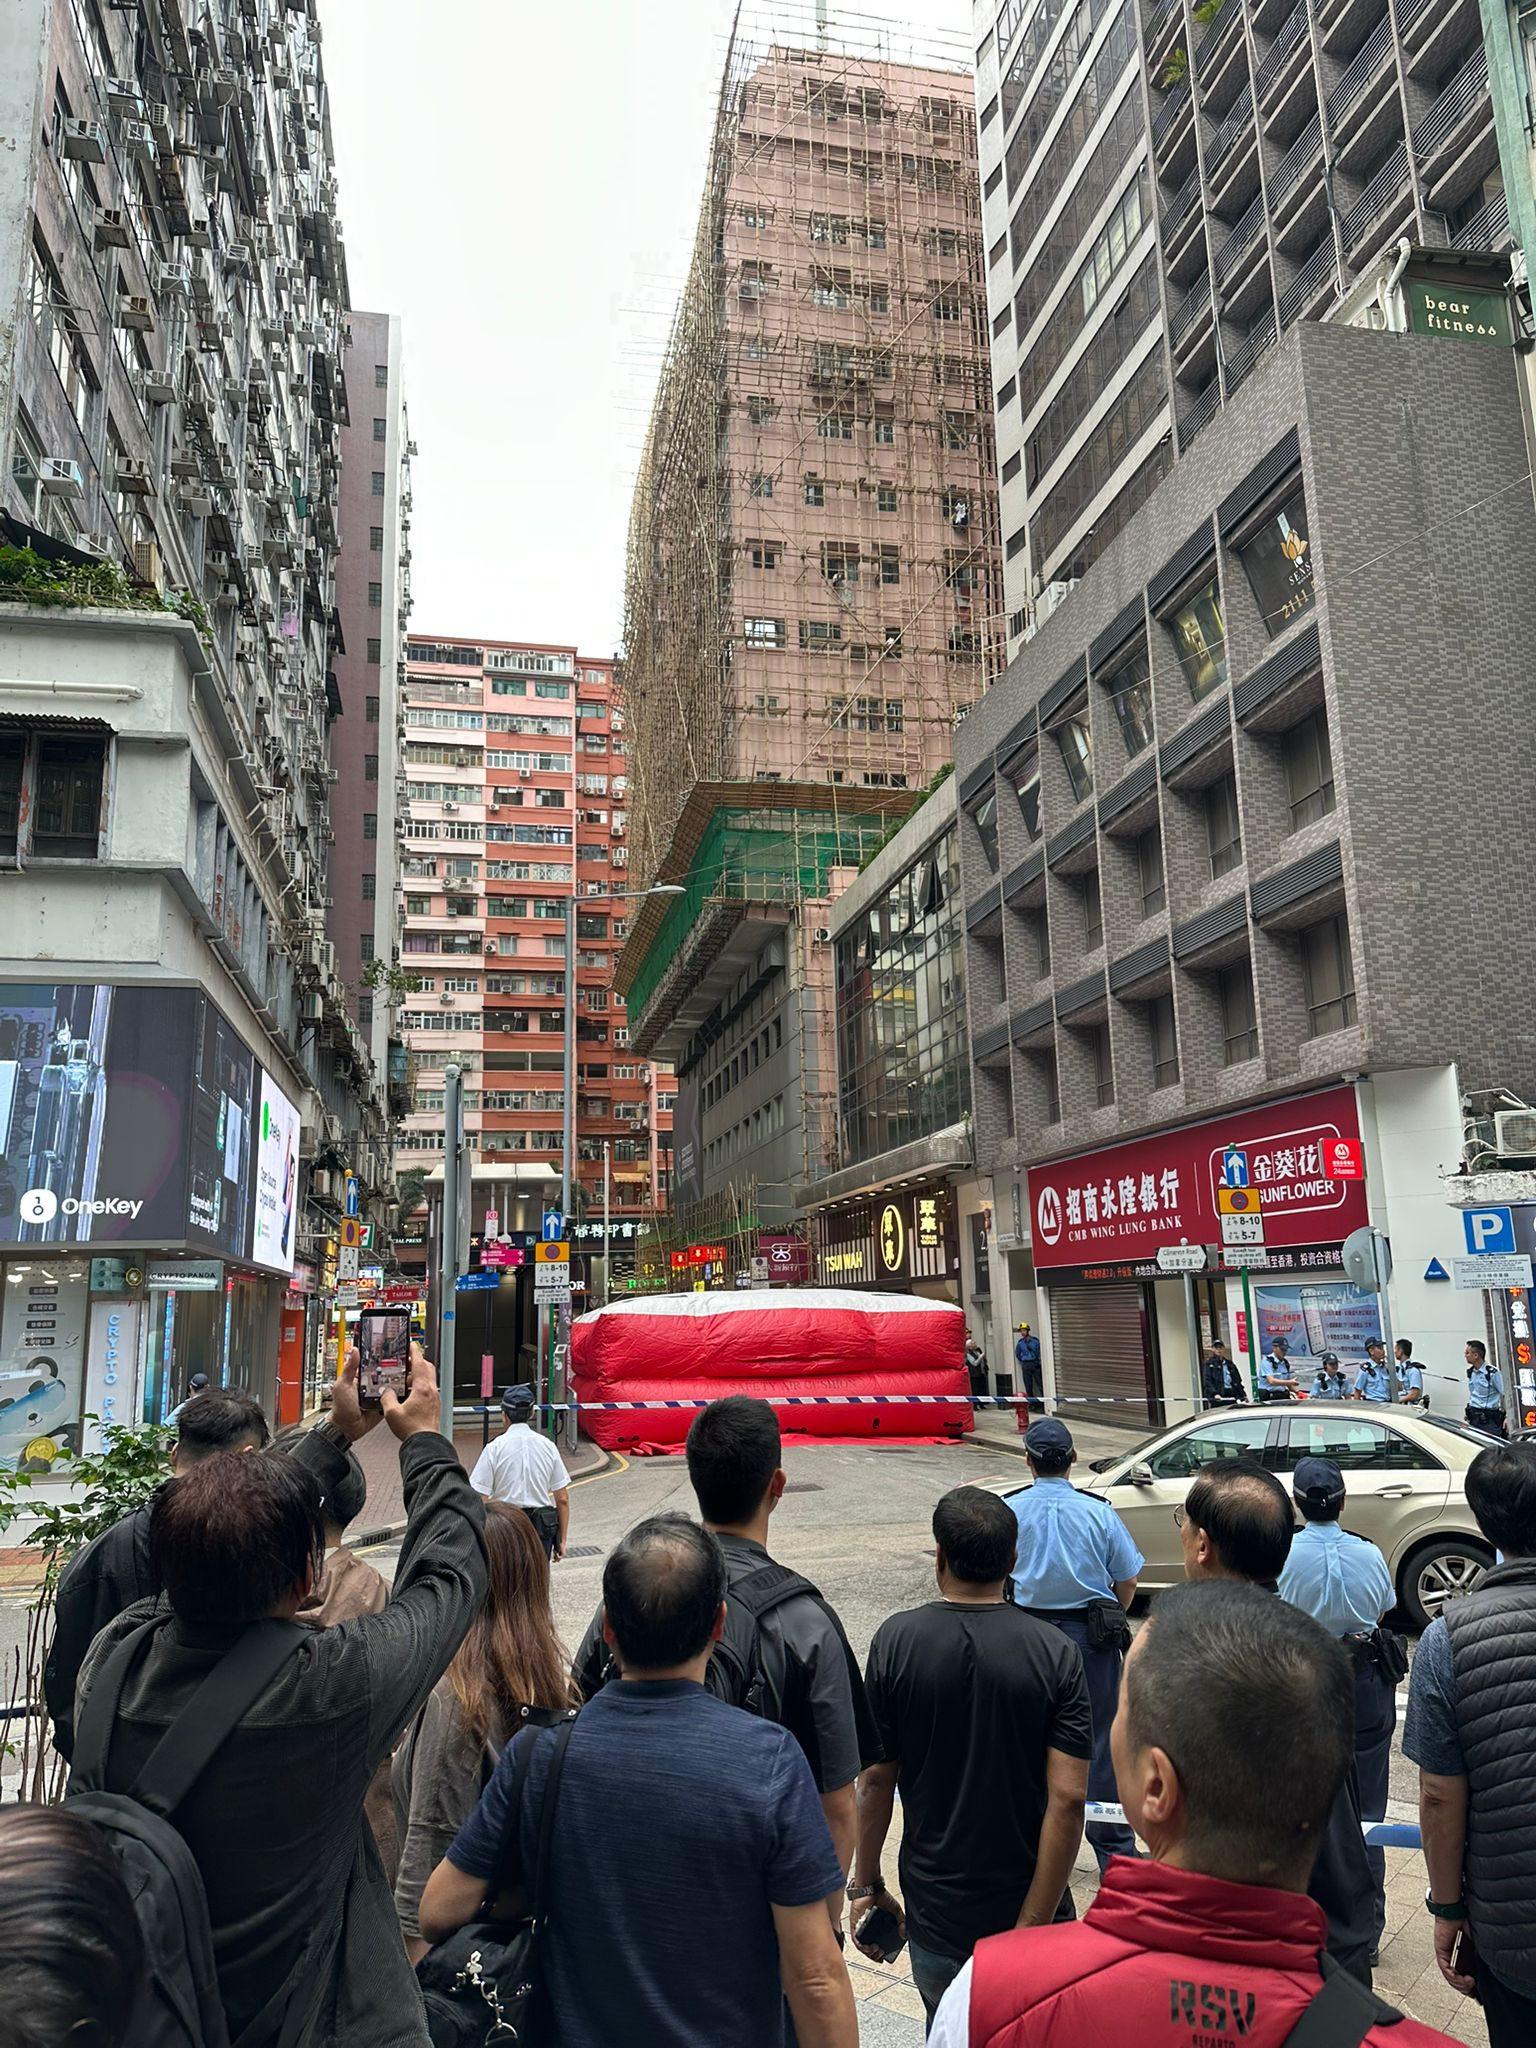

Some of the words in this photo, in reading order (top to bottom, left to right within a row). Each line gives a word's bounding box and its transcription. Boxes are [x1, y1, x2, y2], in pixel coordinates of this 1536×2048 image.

[1425, 295, 1470, 315] bear
[1427, 314, 1497, 336] fitness
[1253, 1145, 1320, 1184] 金葵花
[1066, 1167, 1180, 1225] 招商永隆銀行
[1259, 1180, 1335, 1204] SUNFLOWER
[61, 1197, 143, 1219] OneKey
[1068, 1227, 1087, 1242] CMB
[1090, 1224, 1115, 1239] WING
[1119, 1220, 1147, 1236] LUNG
[1151, 1215, 1183, 1231] BANK
[1239, 1216, 1260, 1225] 8-10
[1471, 1213, 1503, 1250] P
[1242, 1231, 1256, 1240] 5-7
[824, 1254, 843, 1273] TSUI
[842, 1251, 863, 1269] WAH
[151, 1272, 187, 1280] CRYPTO
[103, 1314, 121, 1386] CRYPTO
[1171, 1980, 1256, 2036] RSV
